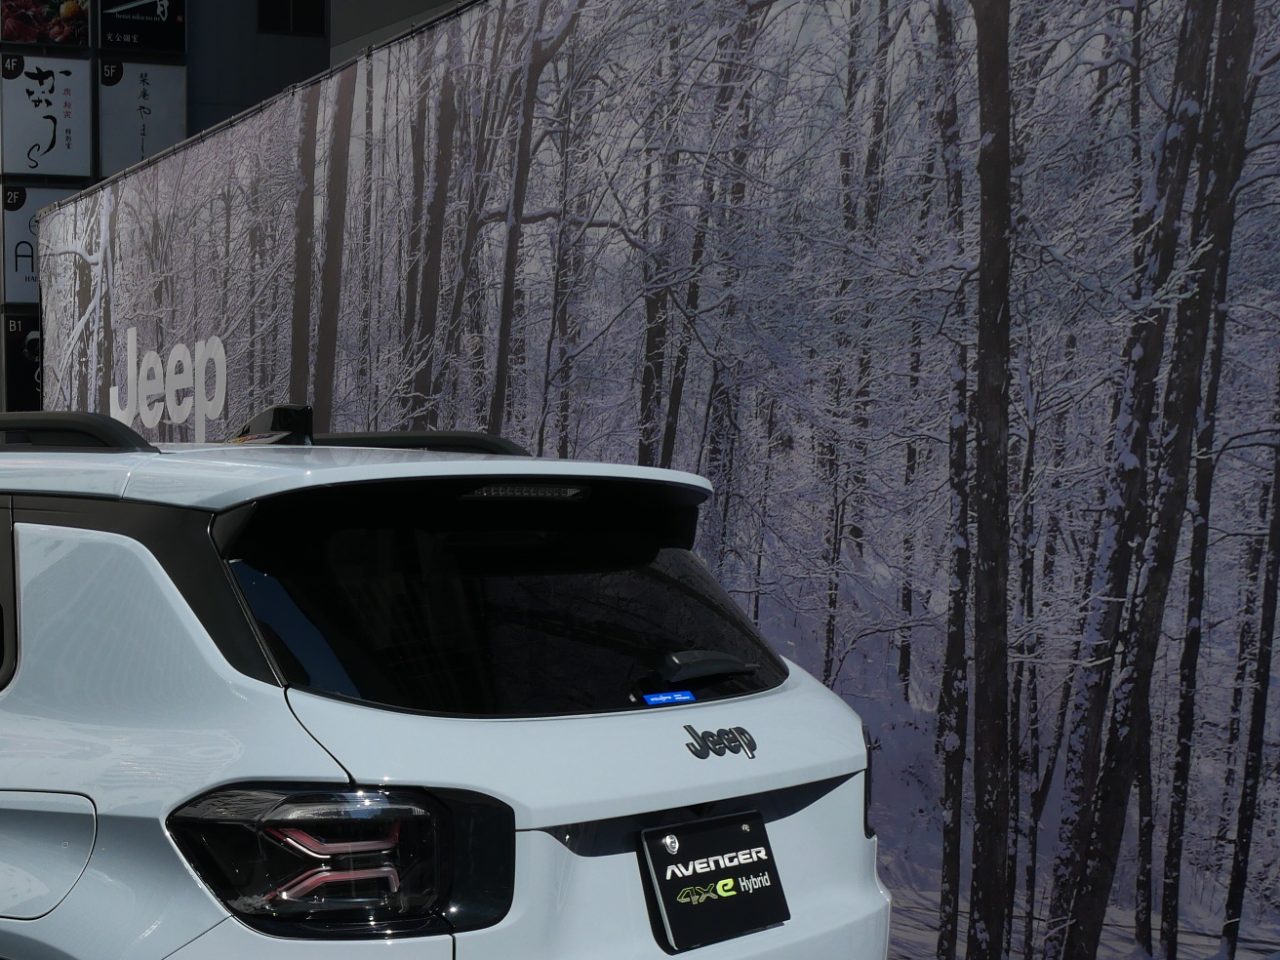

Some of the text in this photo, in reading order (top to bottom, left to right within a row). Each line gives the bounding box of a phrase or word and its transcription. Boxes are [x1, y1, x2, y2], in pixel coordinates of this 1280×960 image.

[4, 58, 18, 71] 4F
[104, 65, 117, 77] 5F
[7, 192, 20, 204] 2F
[8, 320, 22, 332] B1
[110, 327, 227, 441] Jeep
[683, 724, 757, 760] Jeep
[665, 846, 768, 880] AVENGER
[738, 871, 771, 893] Hybrid
